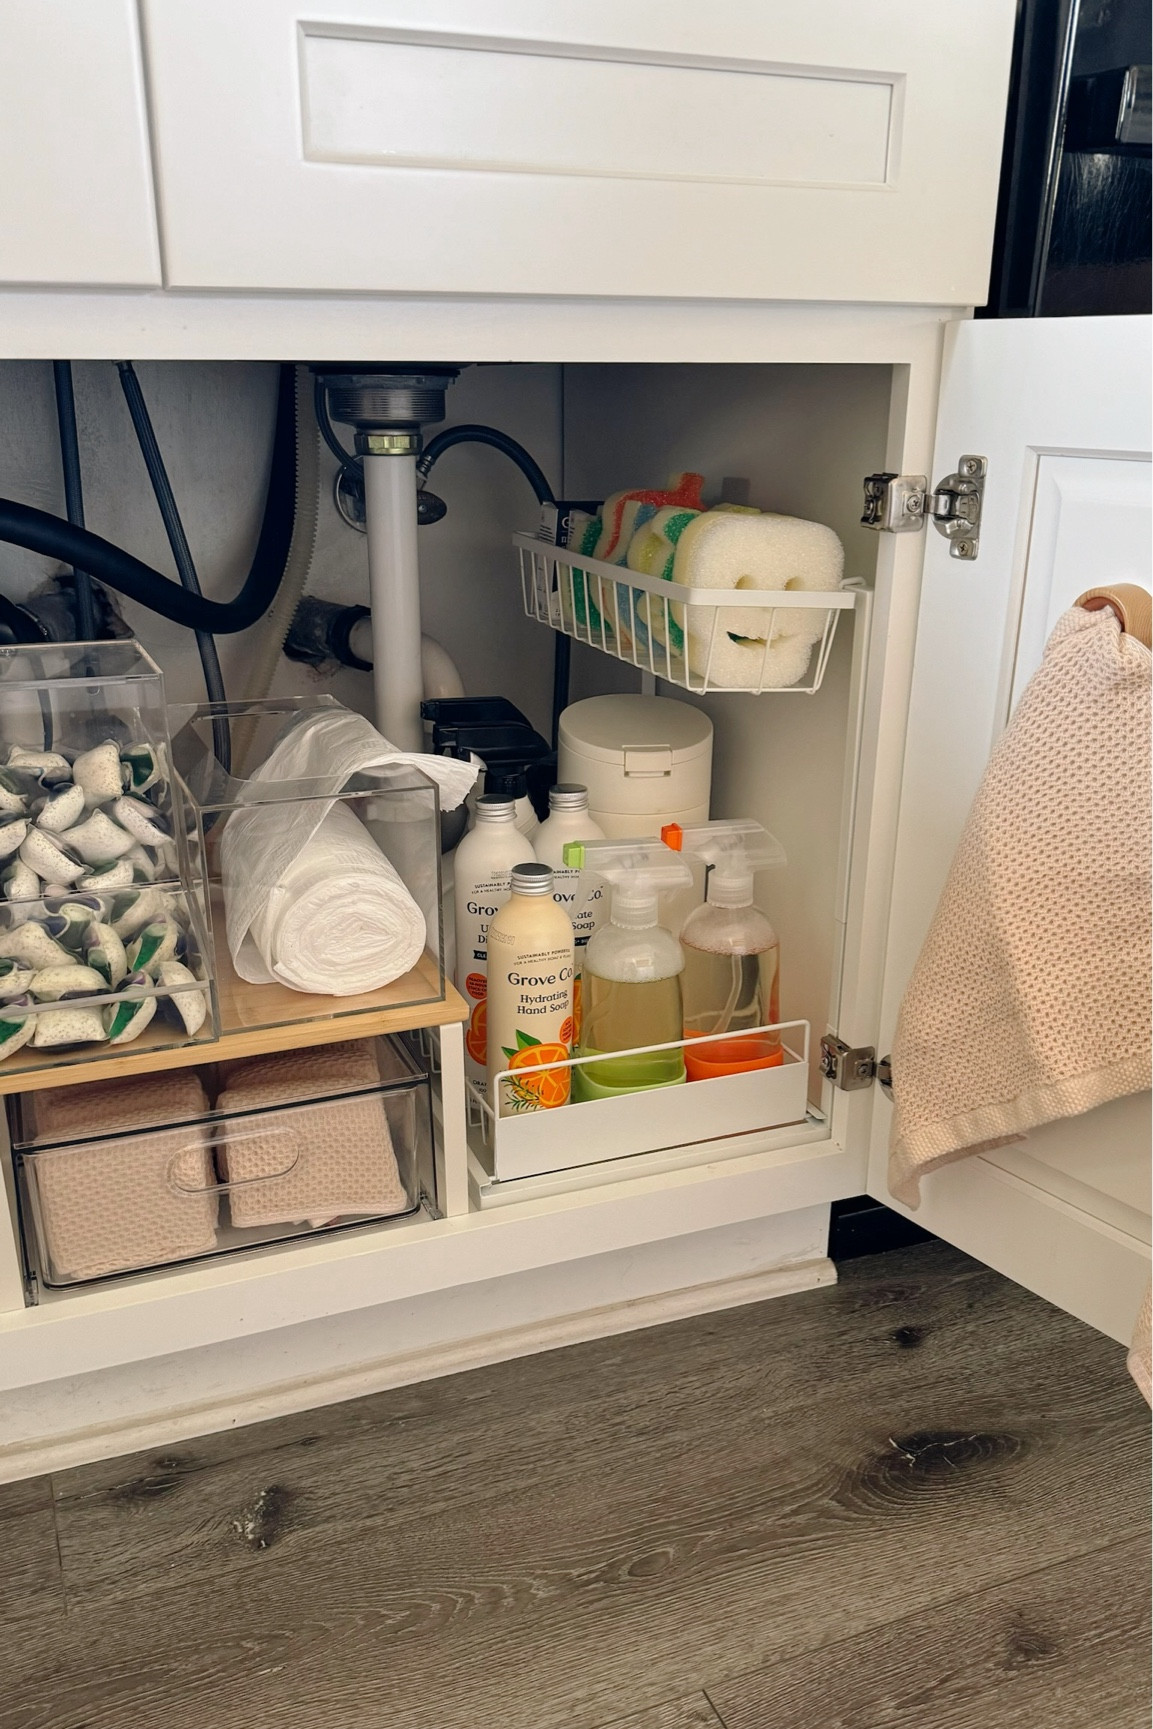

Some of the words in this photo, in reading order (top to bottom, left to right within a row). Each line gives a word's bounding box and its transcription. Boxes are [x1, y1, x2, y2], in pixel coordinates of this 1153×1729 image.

[466, 901, 498, 917] Gro
[572, 921, 595, 931] Soap
[507, 972, 556, 986] Grove
[520, 990, 568, 1005] Hydrating
[517, 1005, 547, 1015] Hand
[549, 999, 570, 1012] Soap
